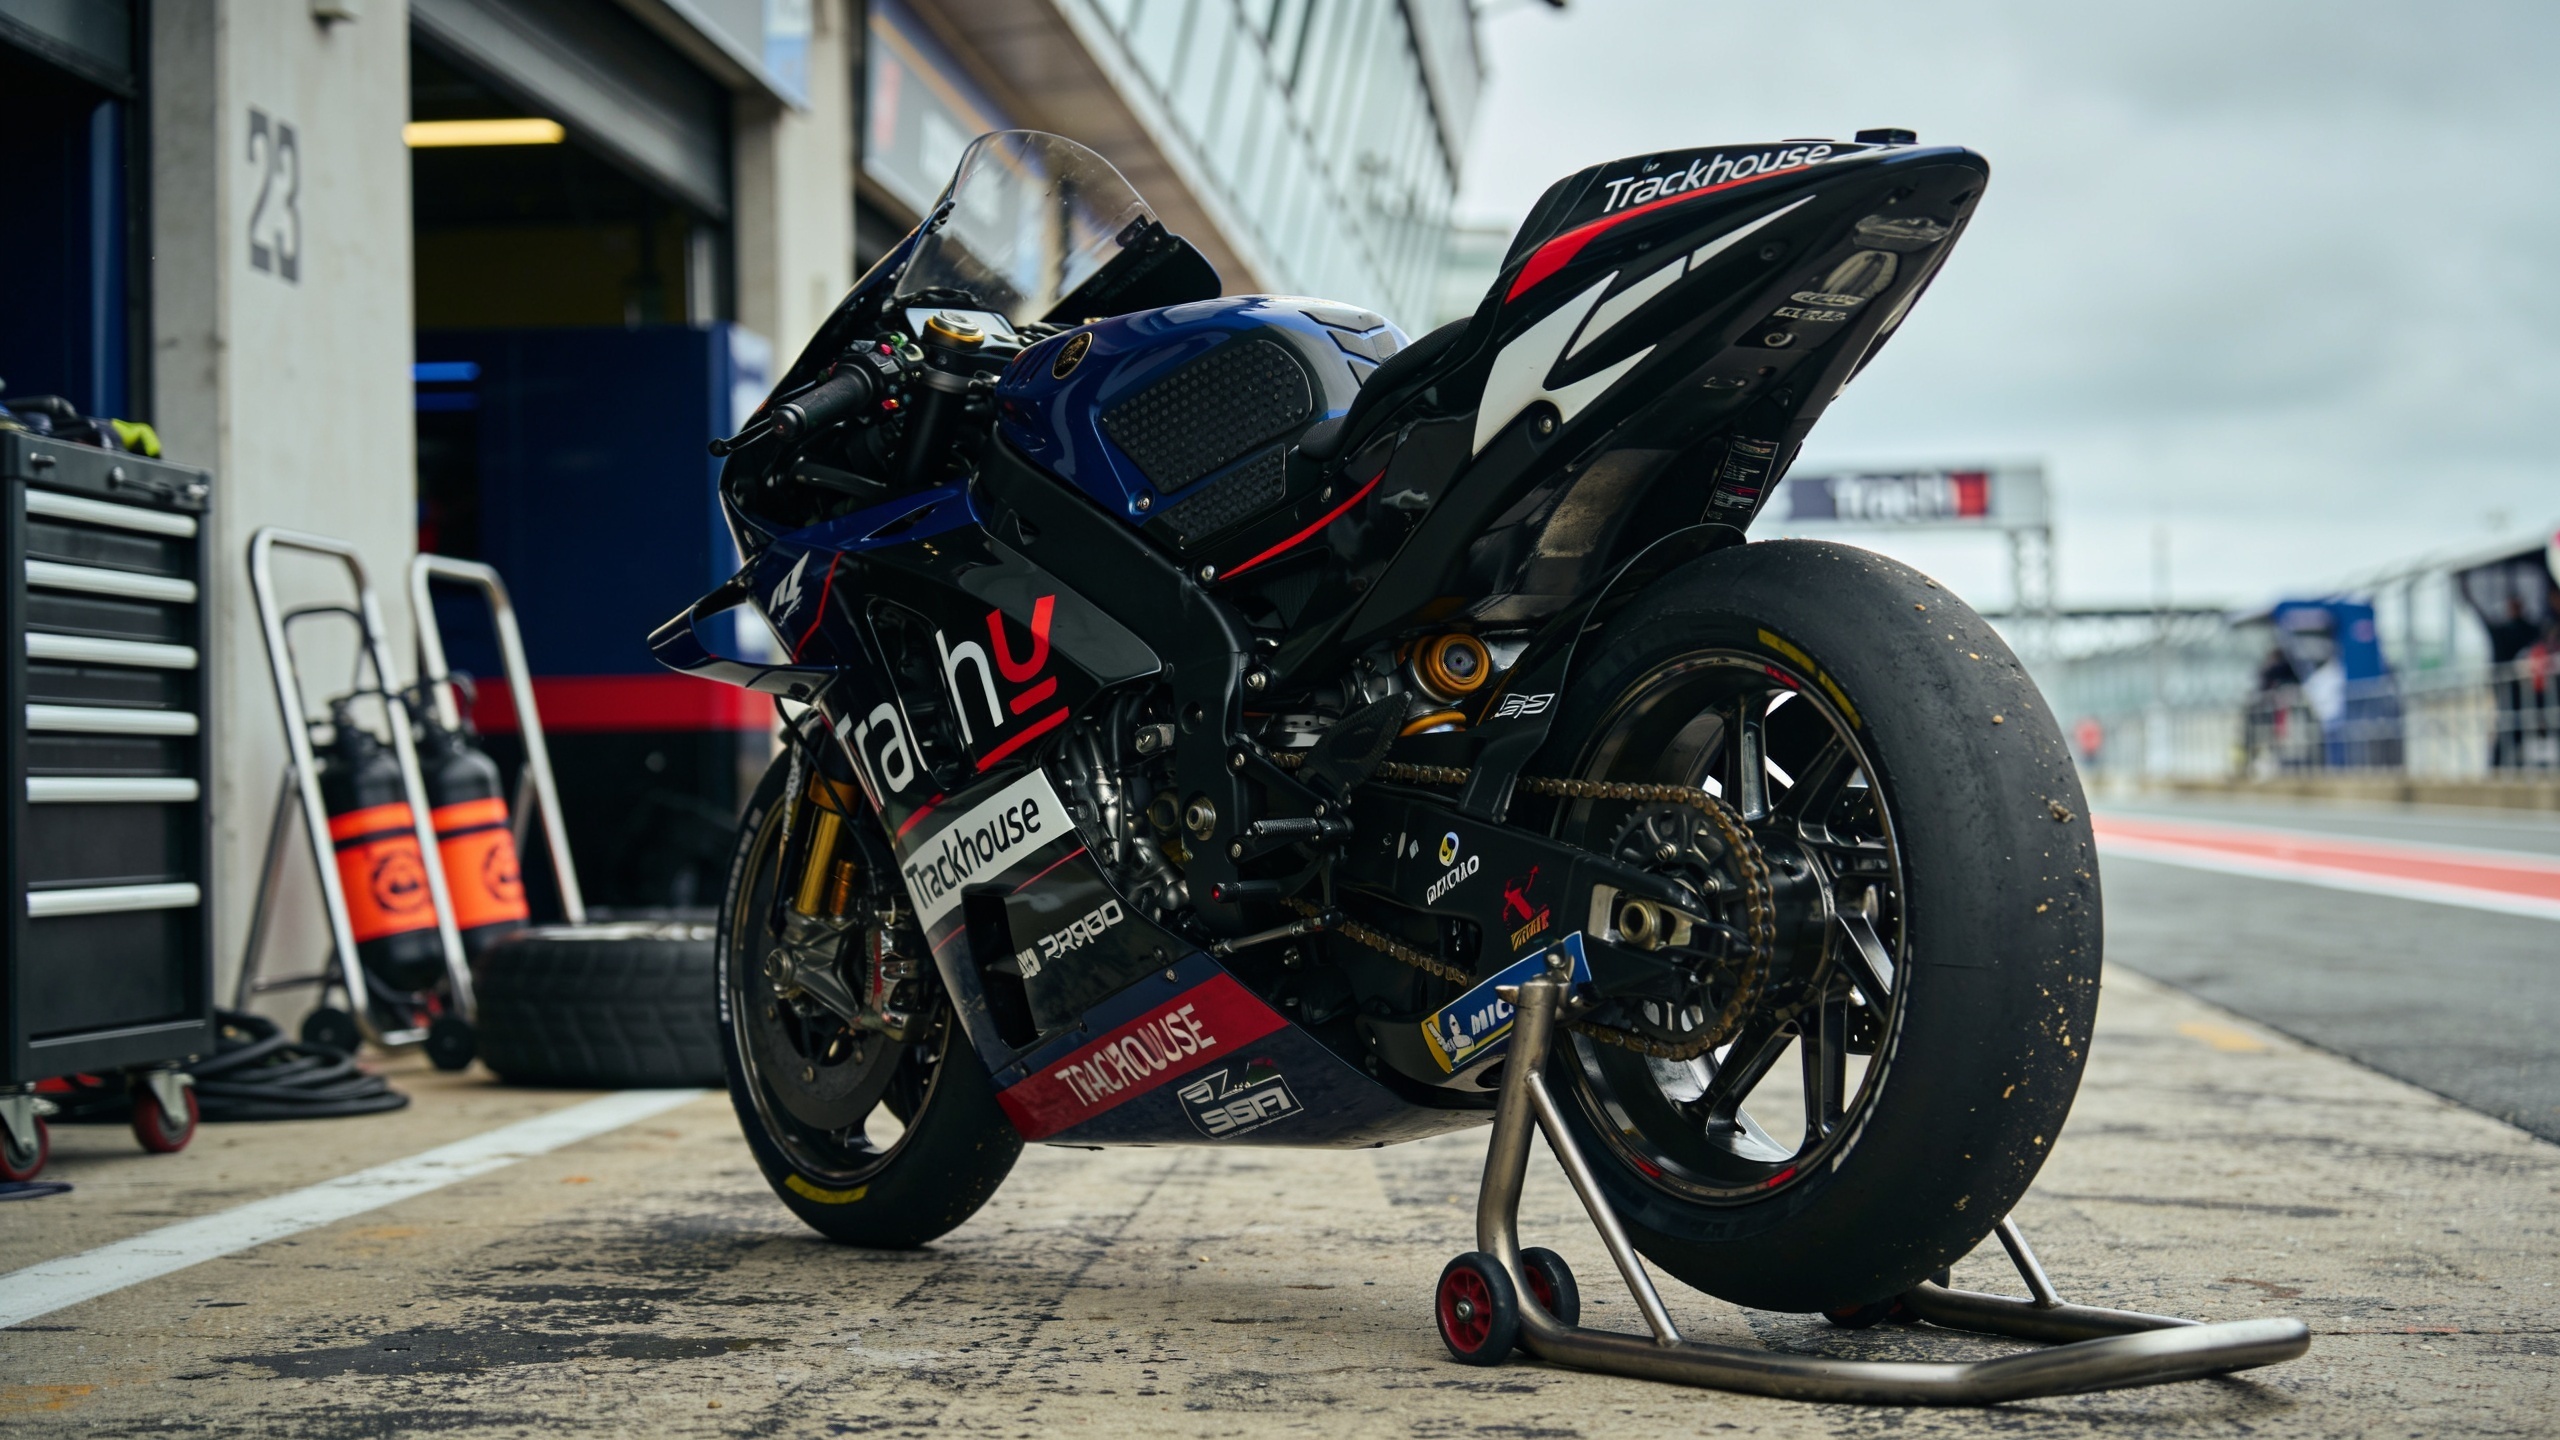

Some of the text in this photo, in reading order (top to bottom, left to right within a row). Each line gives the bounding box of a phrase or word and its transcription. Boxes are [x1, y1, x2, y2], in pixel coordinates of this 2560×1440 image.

[248, 107, 300, 284] 23
[1603, 144, 1833, 213] Trackhouse
[904, 797, 1042, 910] Trackhouse
